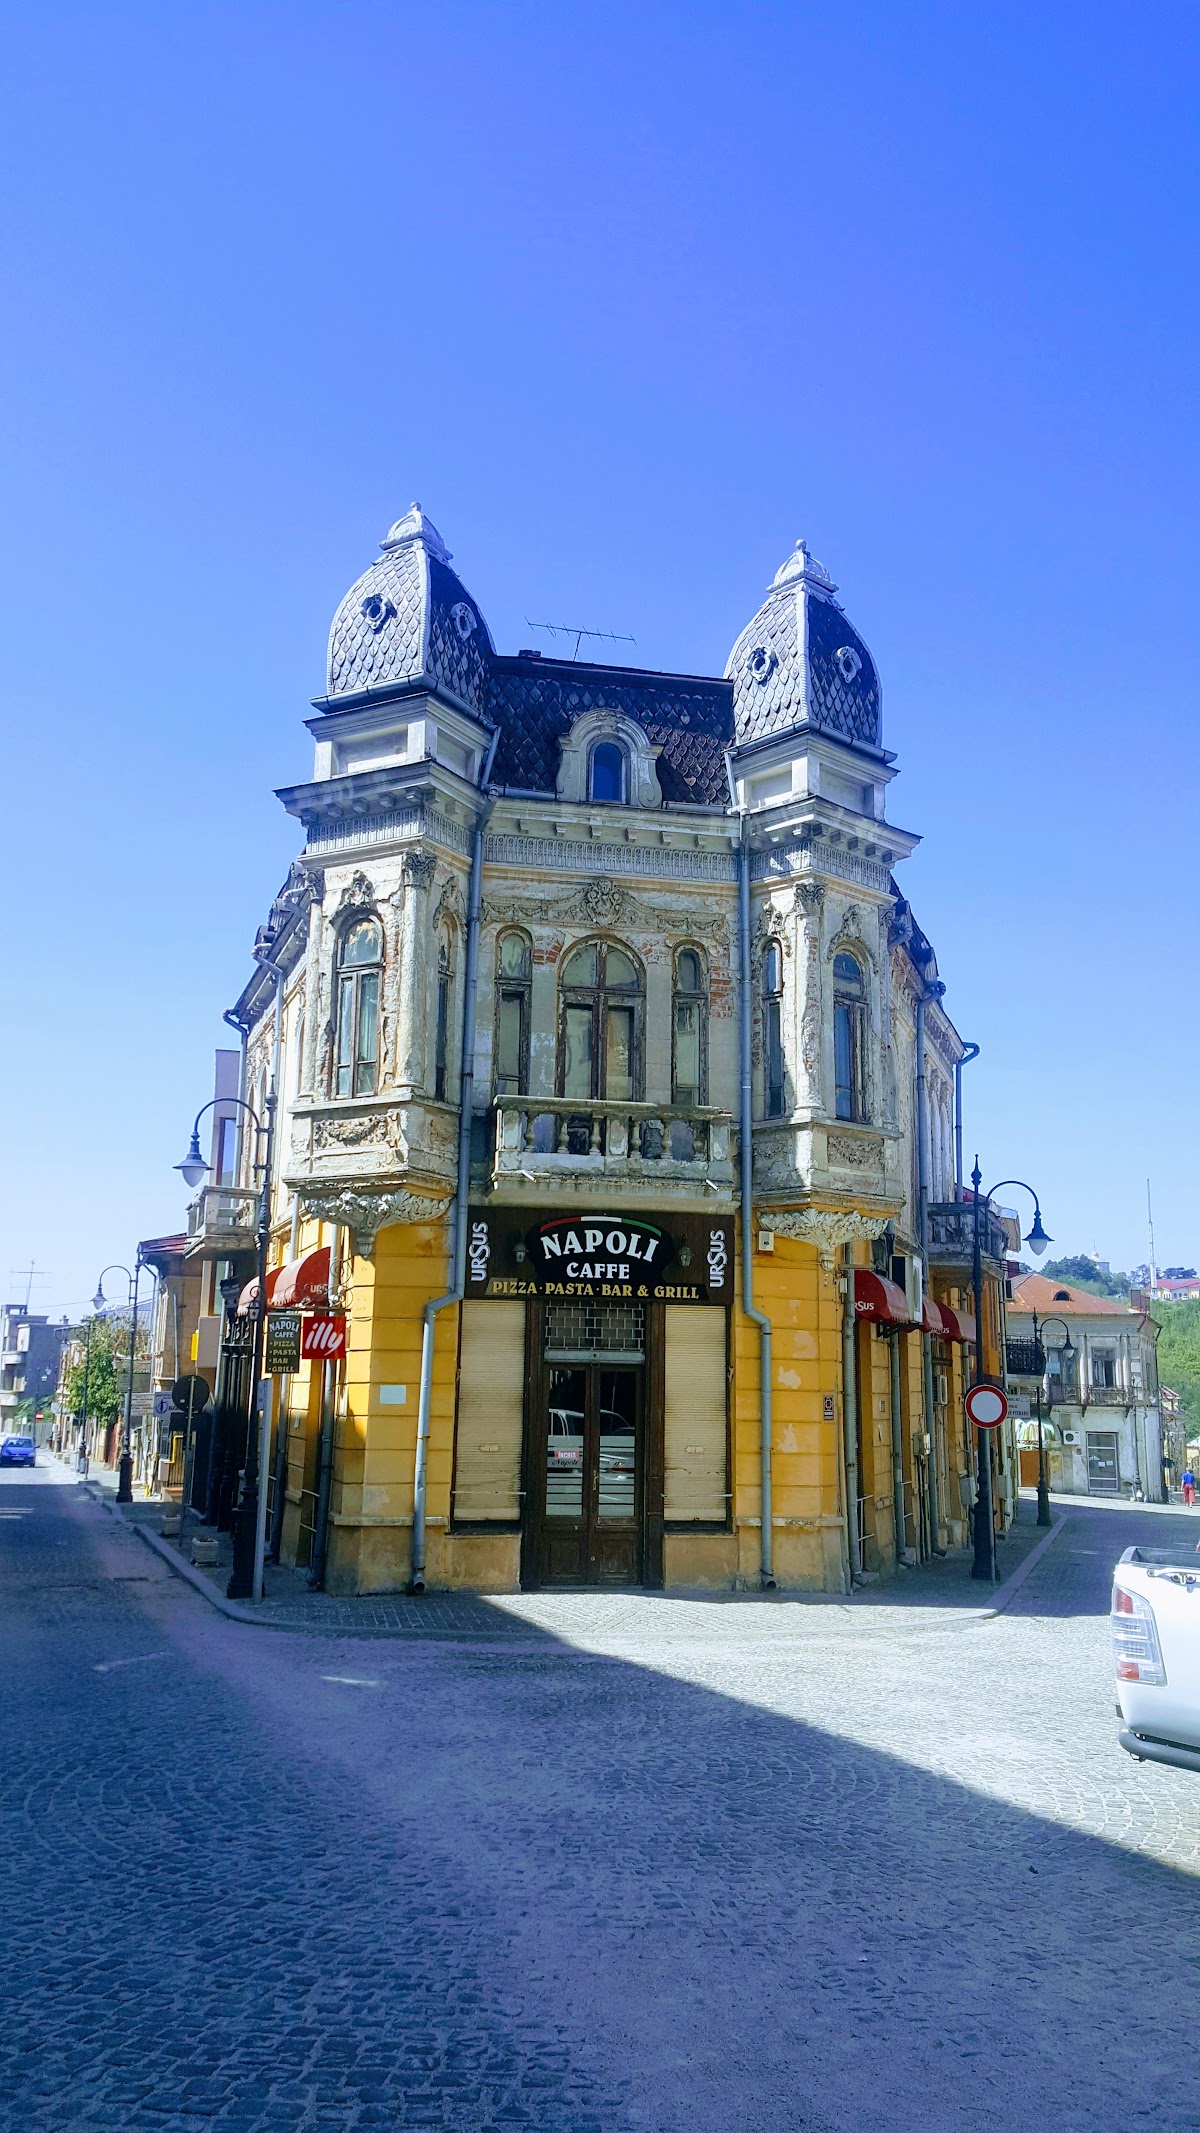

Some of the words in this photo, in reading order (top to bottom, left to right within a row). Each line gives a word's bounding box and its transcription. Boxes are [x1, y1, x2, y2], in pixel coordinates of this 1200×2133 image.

[469, 1222, 490, 1282] URSUS
[540, 1229, 660, 1262] NAPOLI
[707, 1230, 728, 1288] URSUS
[566, 1262, 630, 1279] CAFFE
[492, 1281, 538, 1294] PIZZA
[545, 1282, 594, 1296] PASTA
[602, 1284, 633, 1297] BAR
[637, 1285, 649, 1297] &
[654, 1285, 700, 1299] GRILL
[269, 1320, 300, 1333] NAPOLI
[304, 1321, 344, 1357] illy
